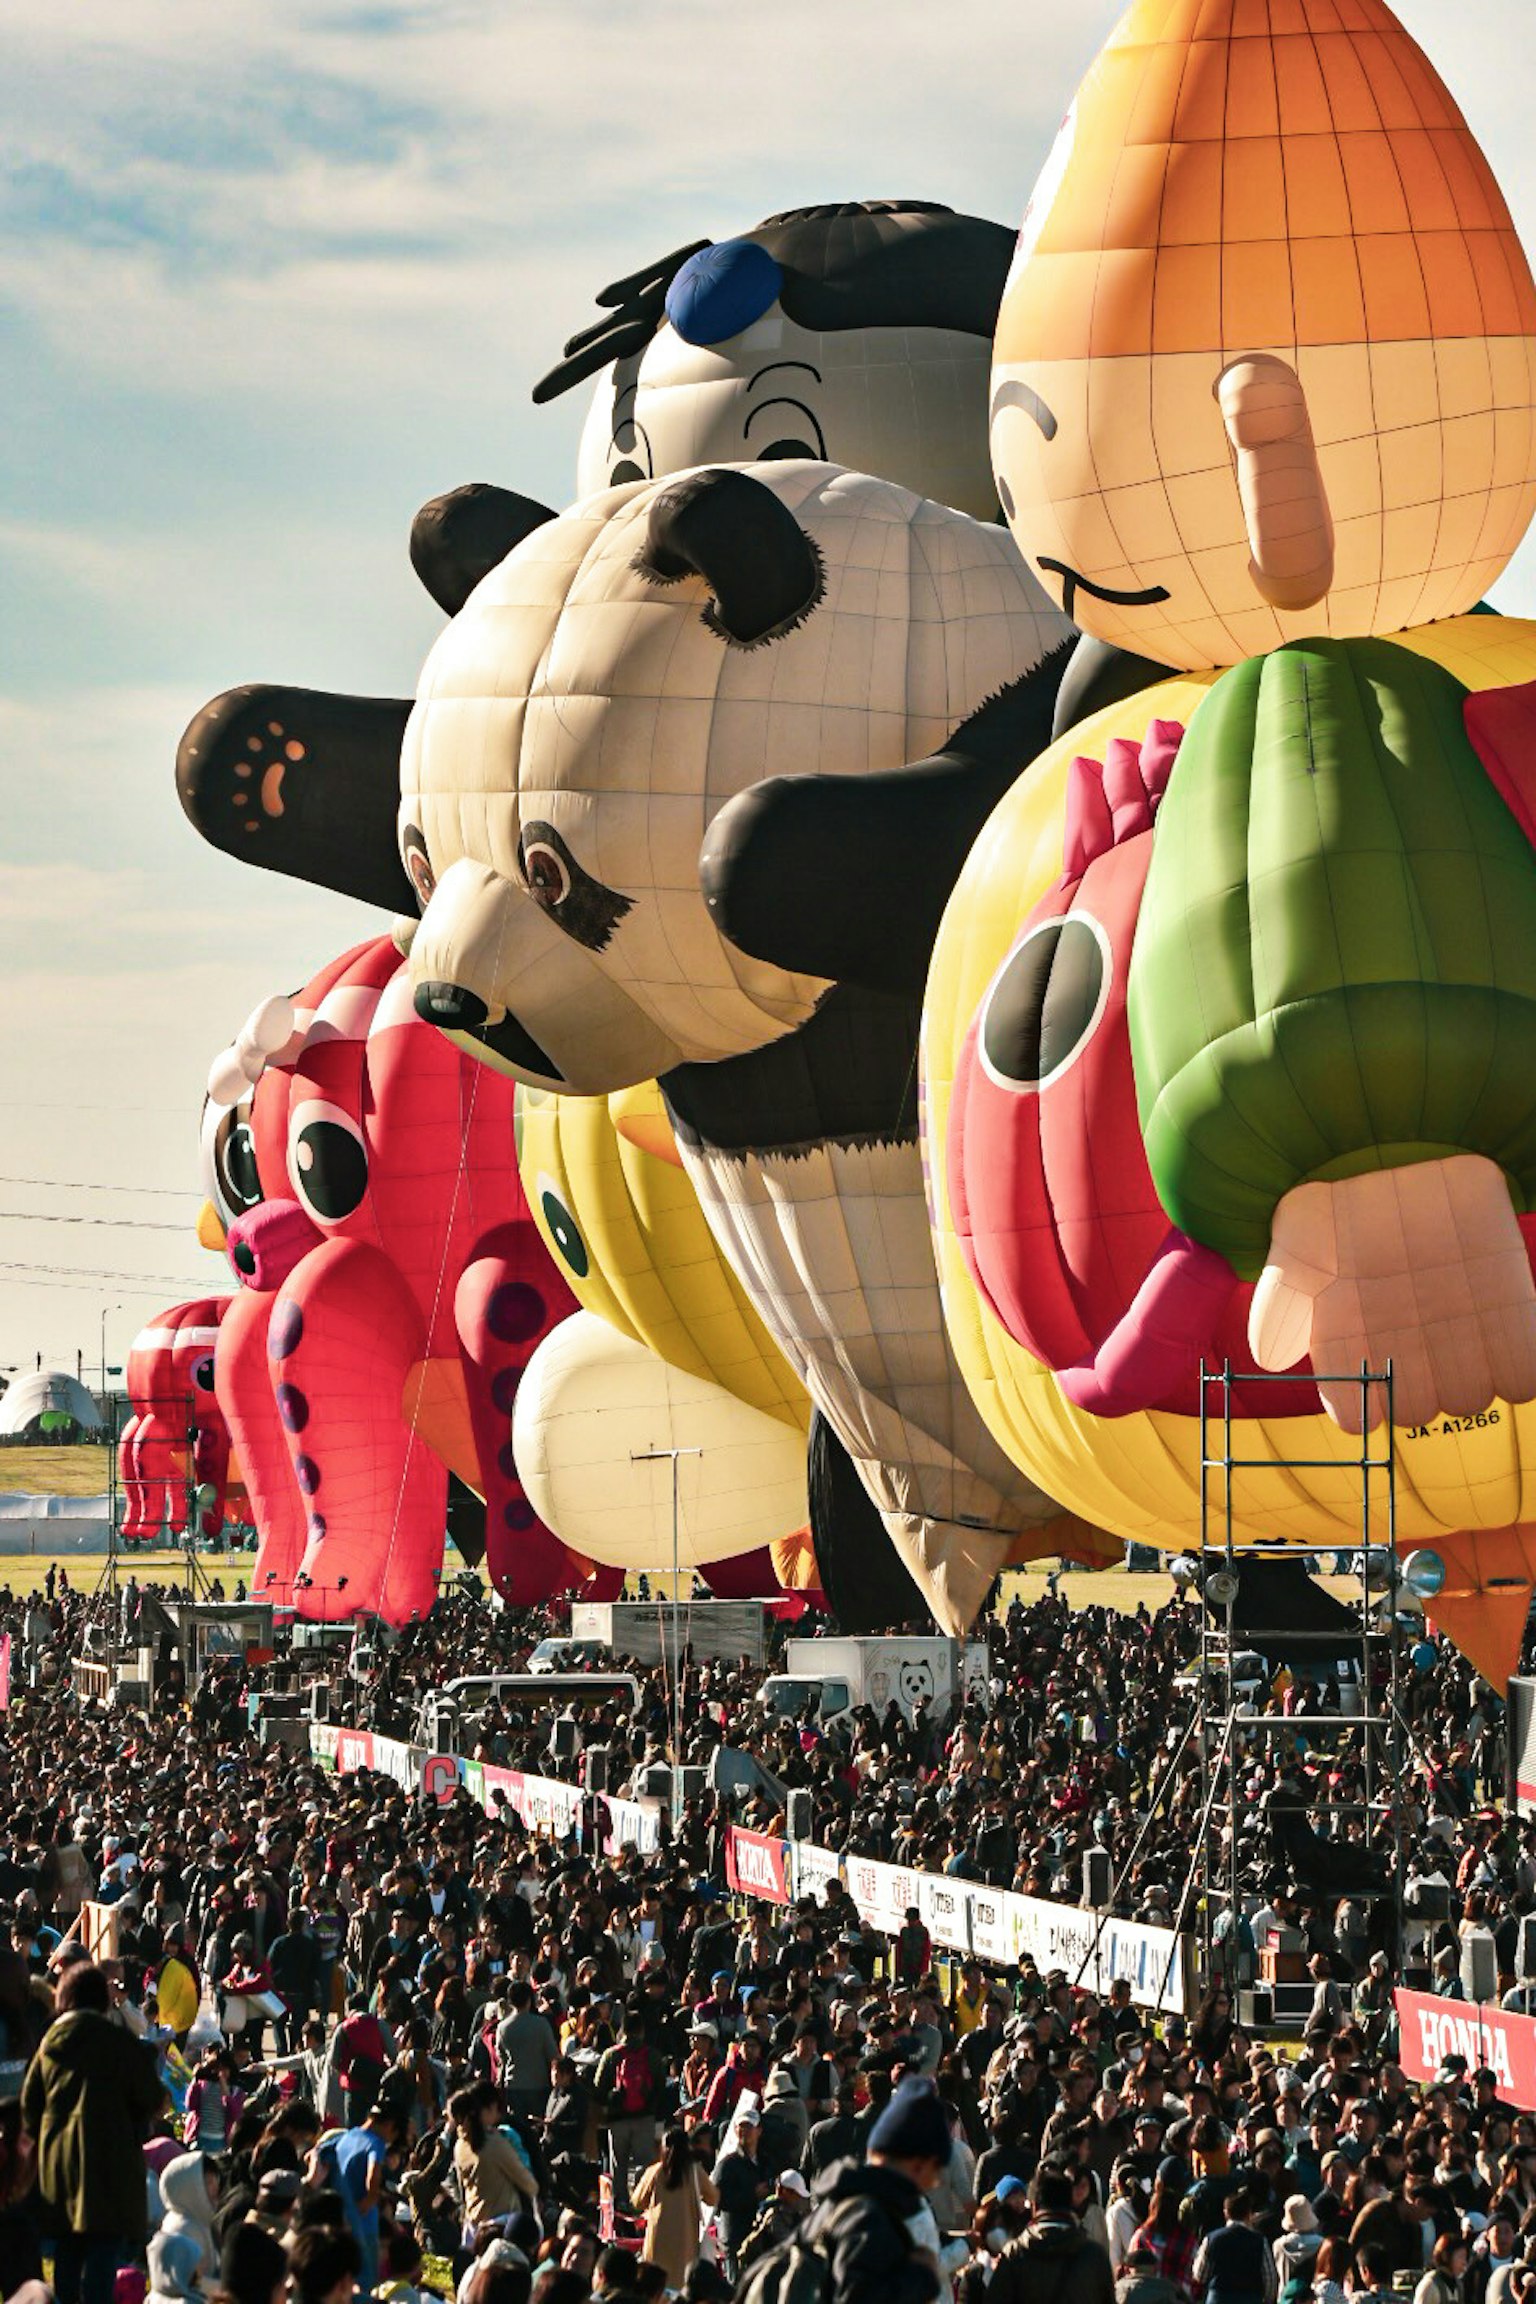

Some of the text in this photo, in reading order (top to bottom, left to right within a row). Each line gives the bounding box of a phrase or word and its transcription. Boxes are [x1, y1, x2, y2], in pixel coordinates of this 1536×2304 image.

[1406, 1410, 1500, 1439] JA-A1266
[425, 1758, 456, 1805] C
[1417, 2009, 1515, 2090] HONDA
